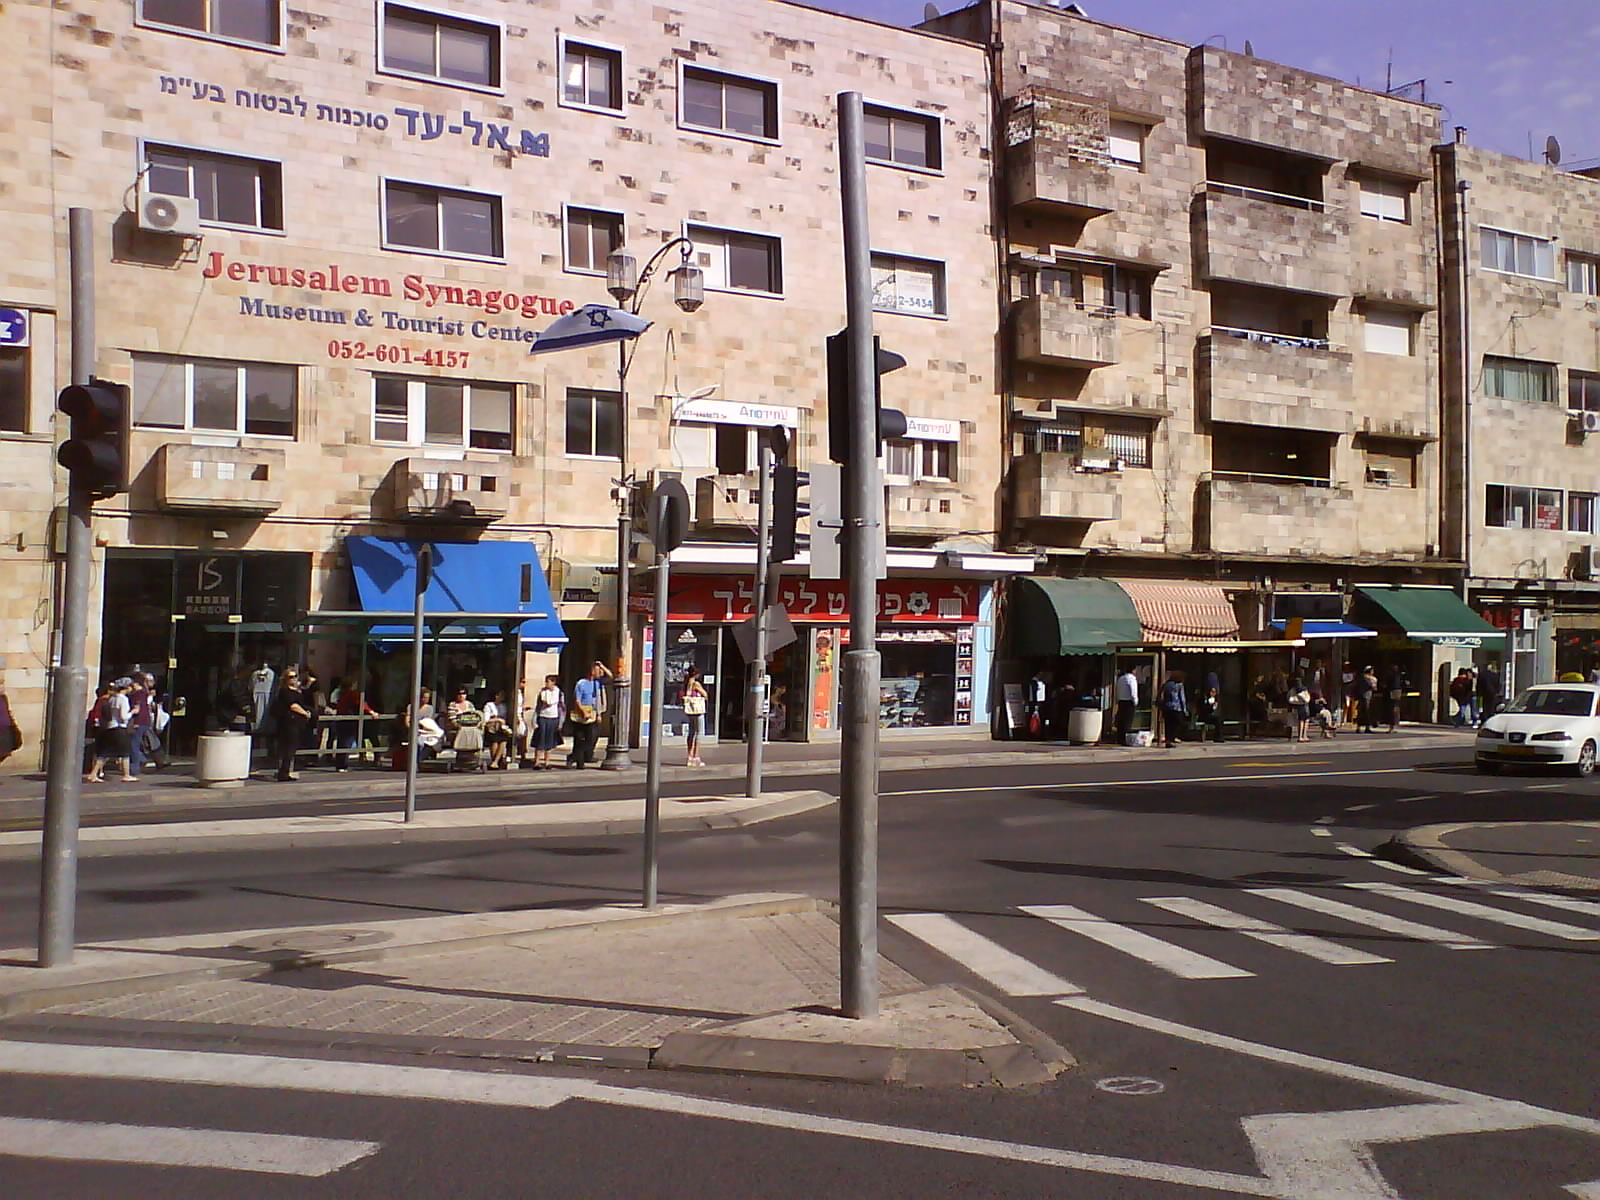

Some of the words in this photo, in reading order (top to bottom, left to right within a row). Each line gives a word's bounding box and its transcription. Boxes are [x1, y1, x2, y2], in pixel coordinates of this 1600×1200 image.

[234, 88, 308, 117] לבטוח
[316, 103, 389, 131] סוכנות
[394, 107, 514, 151] אל-עד
[203, 251, 392, 297] Jerusalem
[403, 273, 575, 319] Synagogue
[239, 296, 347, 325] Museum
[354, 308, 374, 327] &
[381, 311, 465, 336] Tourist
[328, 339, 470, 369] 052-601-4157
